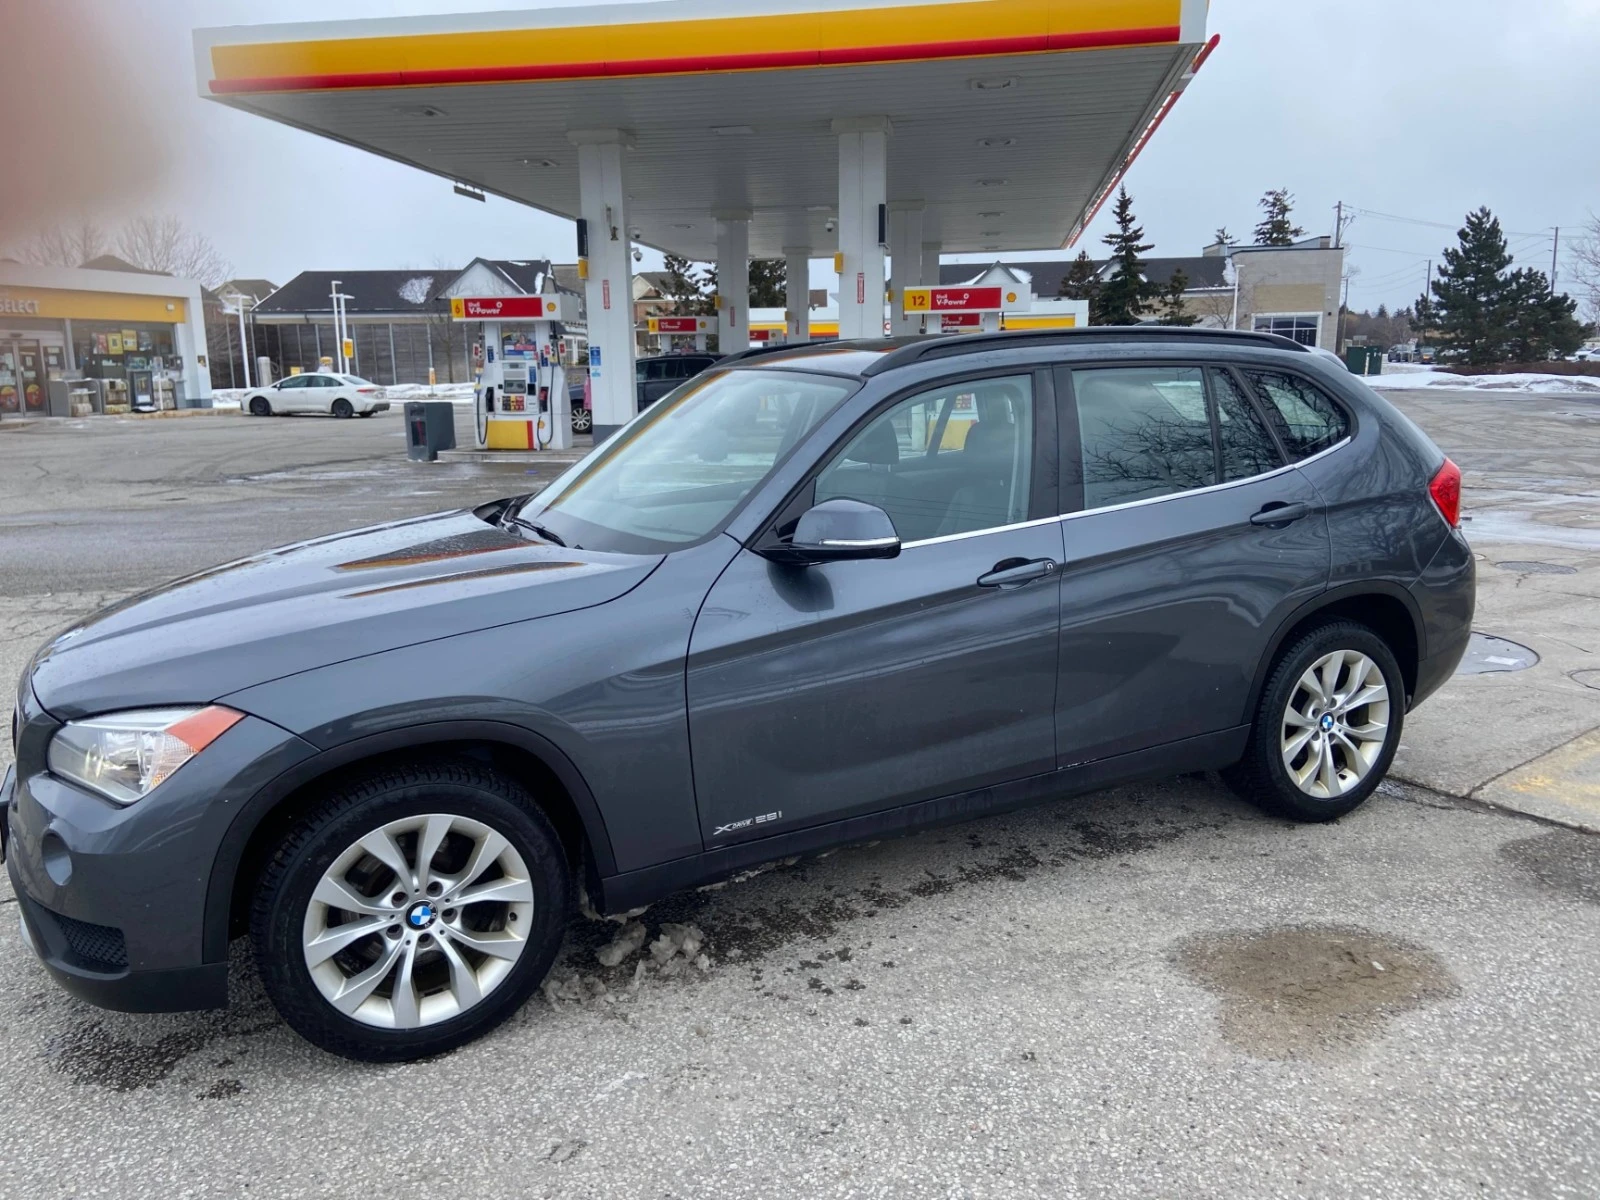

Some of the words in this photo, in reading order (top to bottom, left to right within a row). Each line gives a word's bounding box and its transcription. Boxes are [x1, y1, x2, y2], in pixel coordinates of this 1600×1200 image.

[911, 295, 925, 306] 12
[0, 299, 40, 314] SELECT
[454, 303, 461, 314] 6
[468, 306, 501, 315] V-Power
